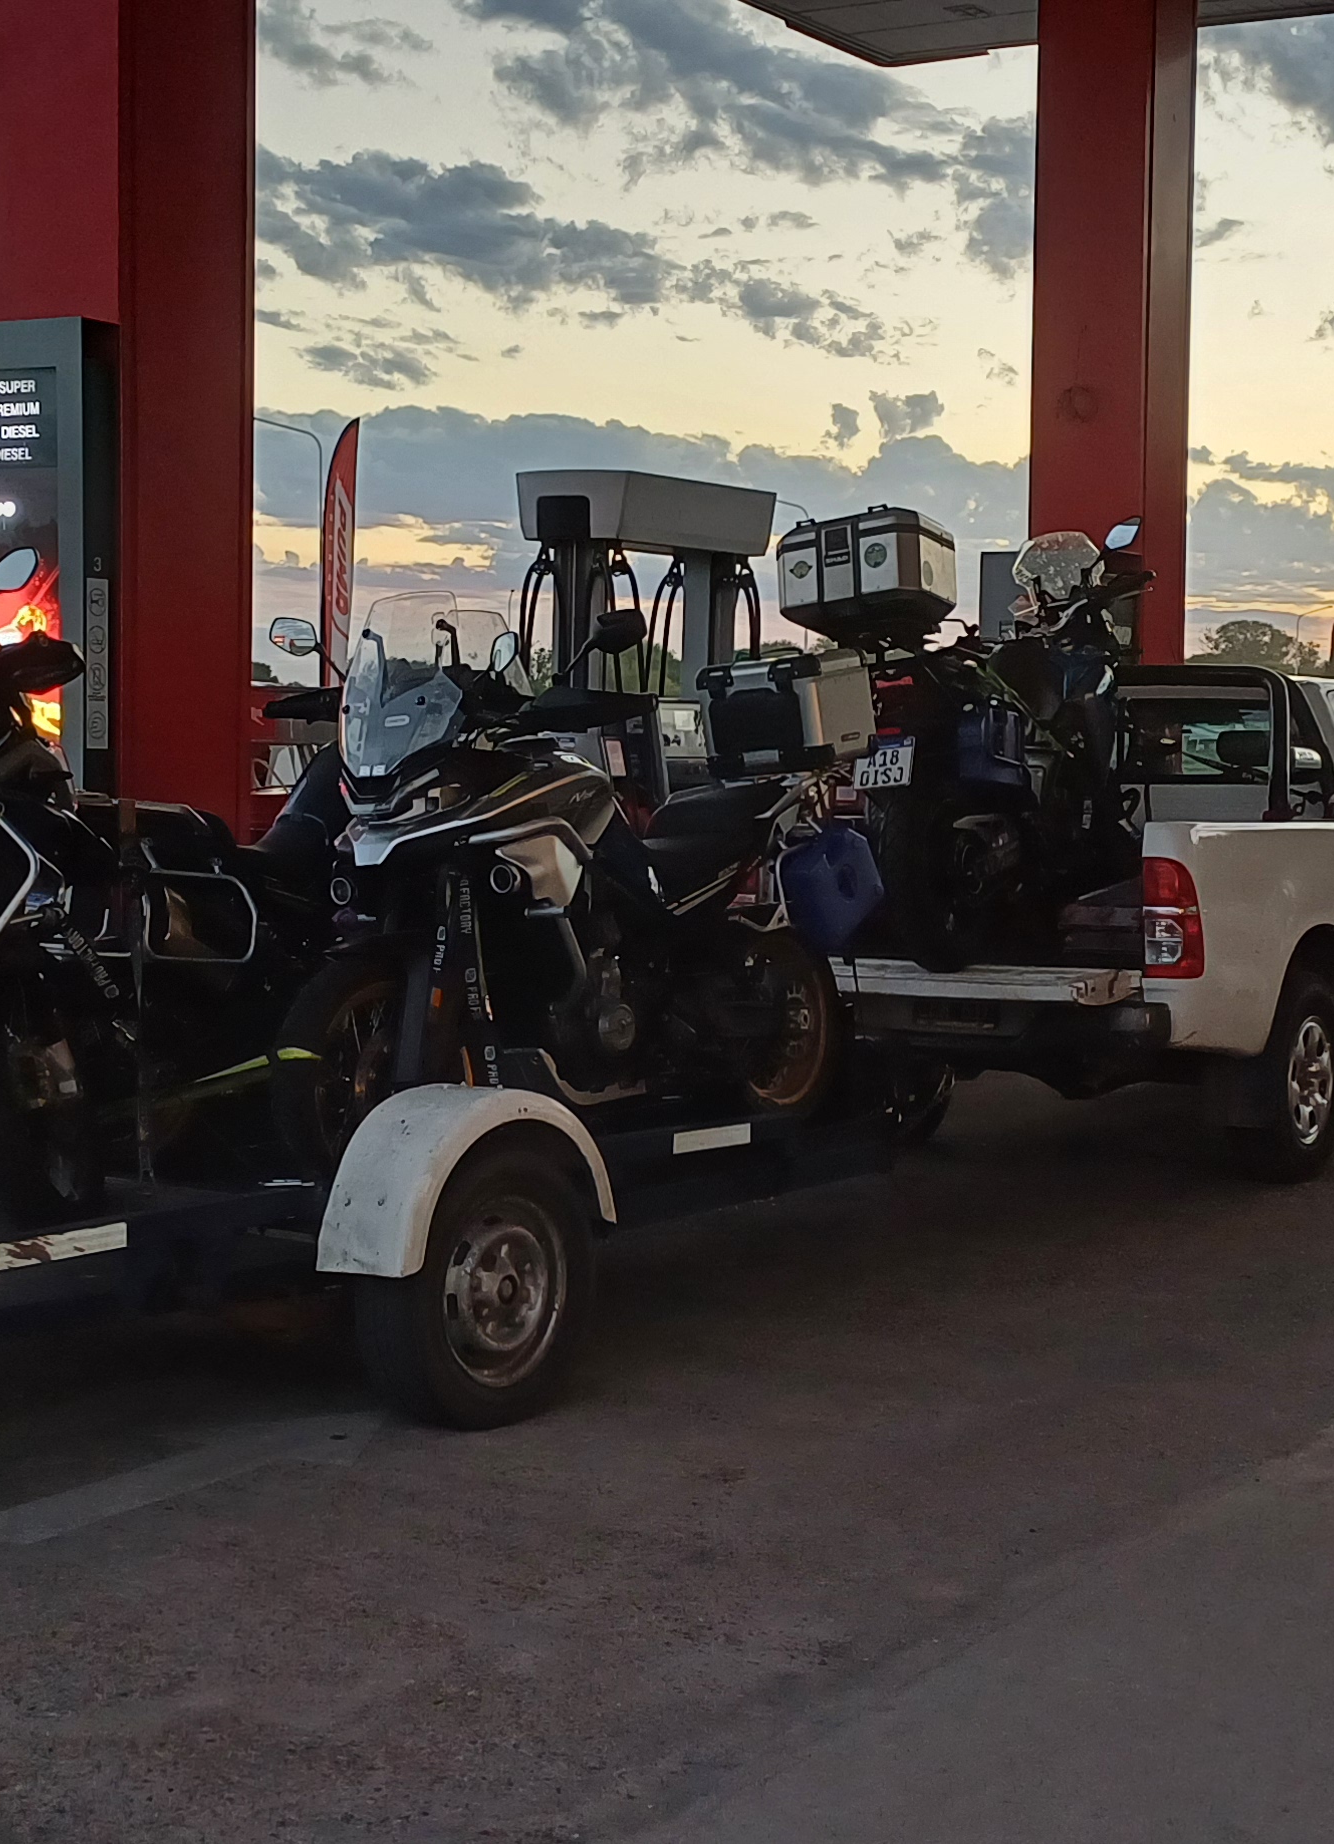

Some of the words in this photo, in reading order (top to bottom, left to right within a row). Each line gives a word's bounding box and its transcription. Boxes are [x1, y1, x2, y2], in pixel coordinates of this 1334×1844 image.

[1, 424, 40, 439] DIESEL
[93, 557, 102, 572] 3
[867, 750, 900, 768] A18
